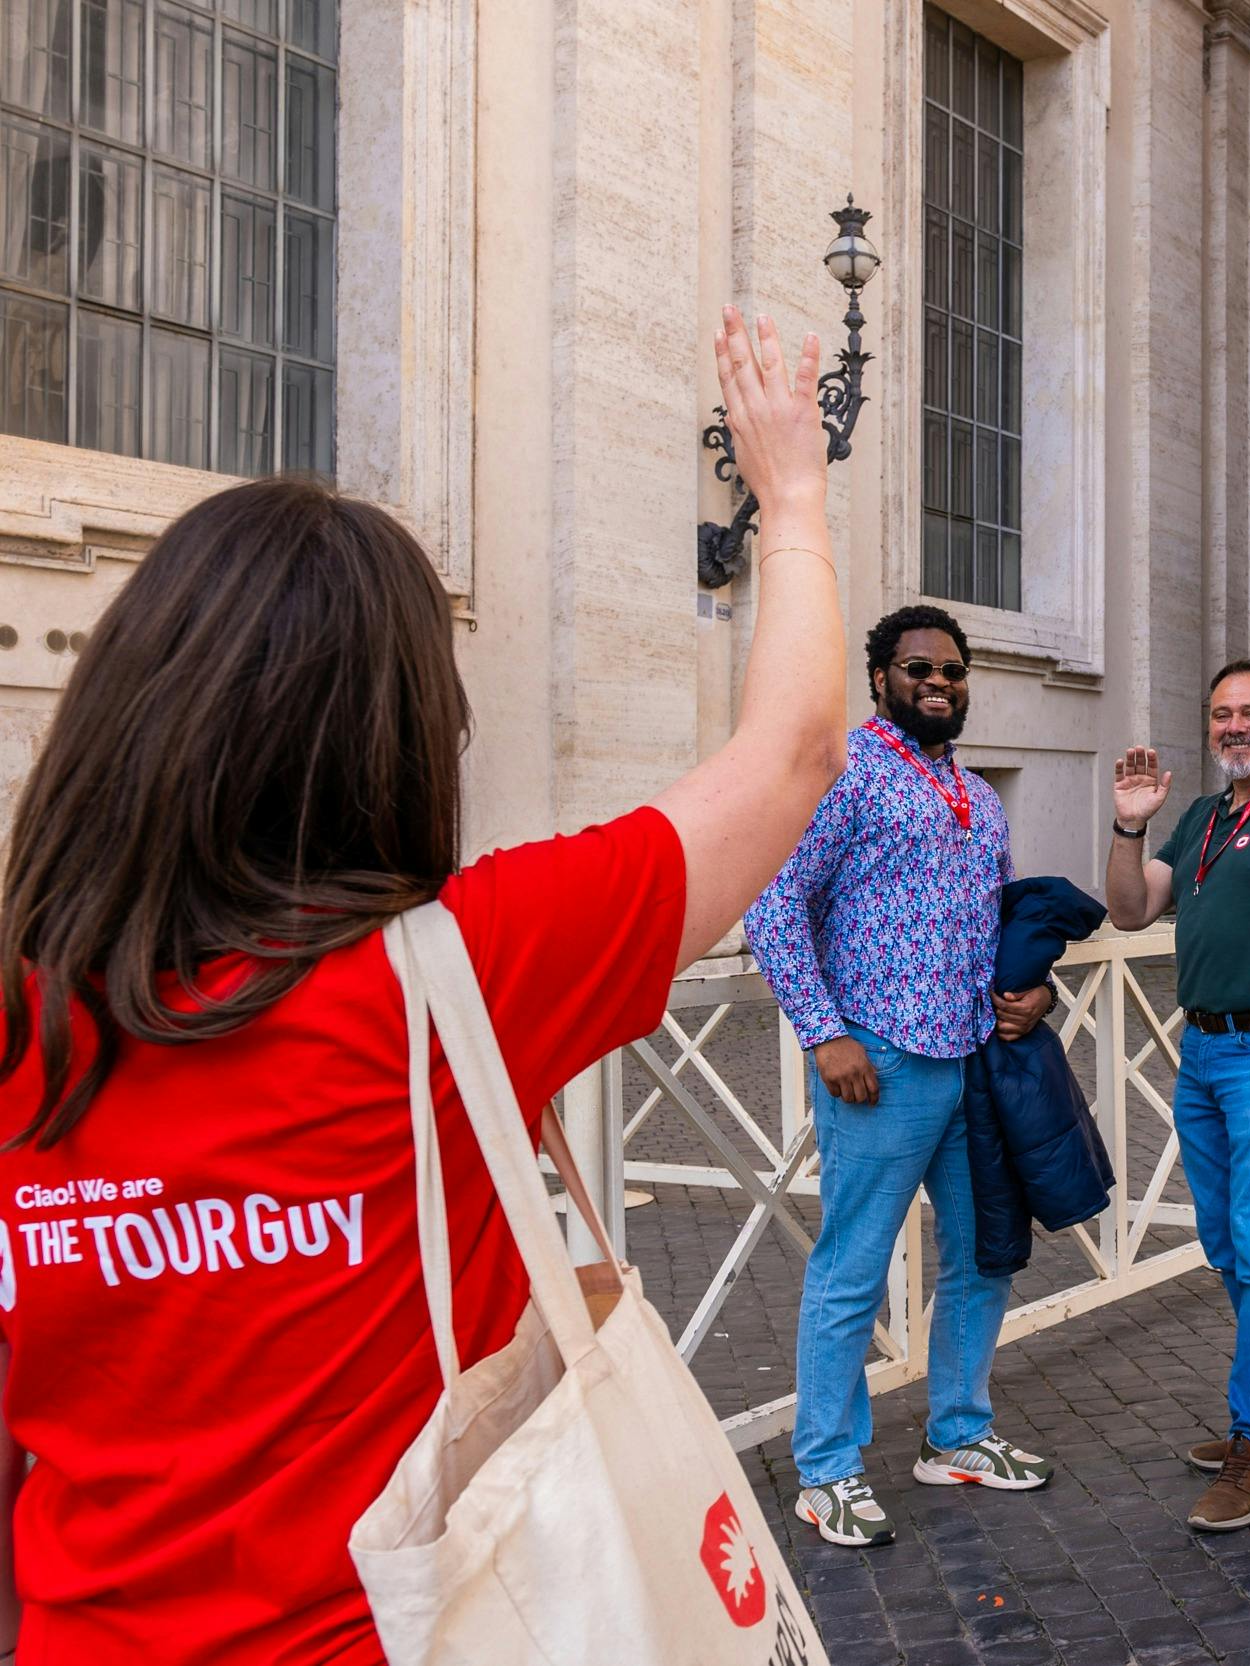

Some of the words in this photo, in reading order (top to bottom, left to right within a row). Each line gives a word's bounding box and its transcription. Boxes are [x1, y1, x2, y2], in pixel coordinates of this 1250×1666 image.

[15, 1180, 77, 1210] Ciao!
[78, 1178, 118, 1203] We
[122, 1177, 164, 1199] are
[18, 1218, 84, 1267] THE
[83, 1198, 245, 1287] TOUR
